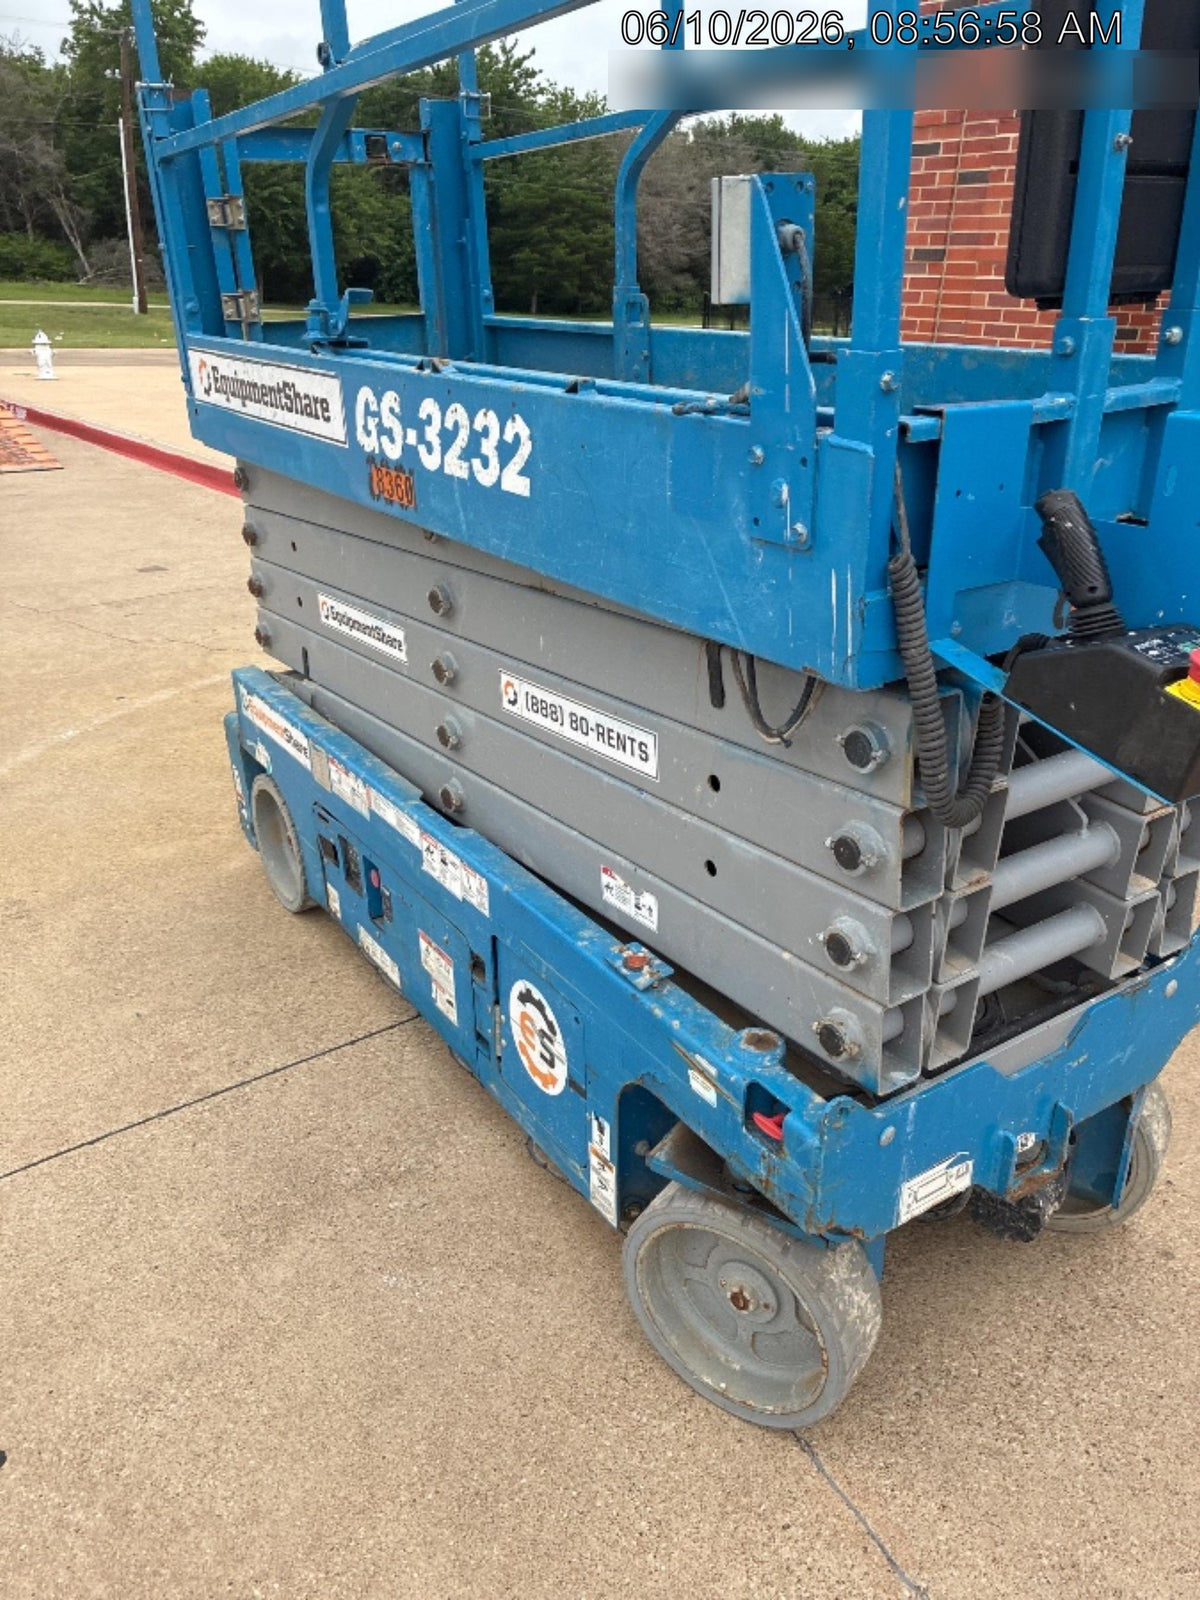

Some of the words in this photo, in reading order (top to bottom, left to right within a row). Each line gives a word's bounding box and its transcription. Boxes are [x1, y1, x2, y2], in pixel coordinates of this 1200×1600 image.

[210, 364, 332, 423] EquipmentShare
[355, 385, 533, 498] GS-3232
[525, 691, 565, 727] (888)
[568, 710, 650, 763] 80-RENTS
